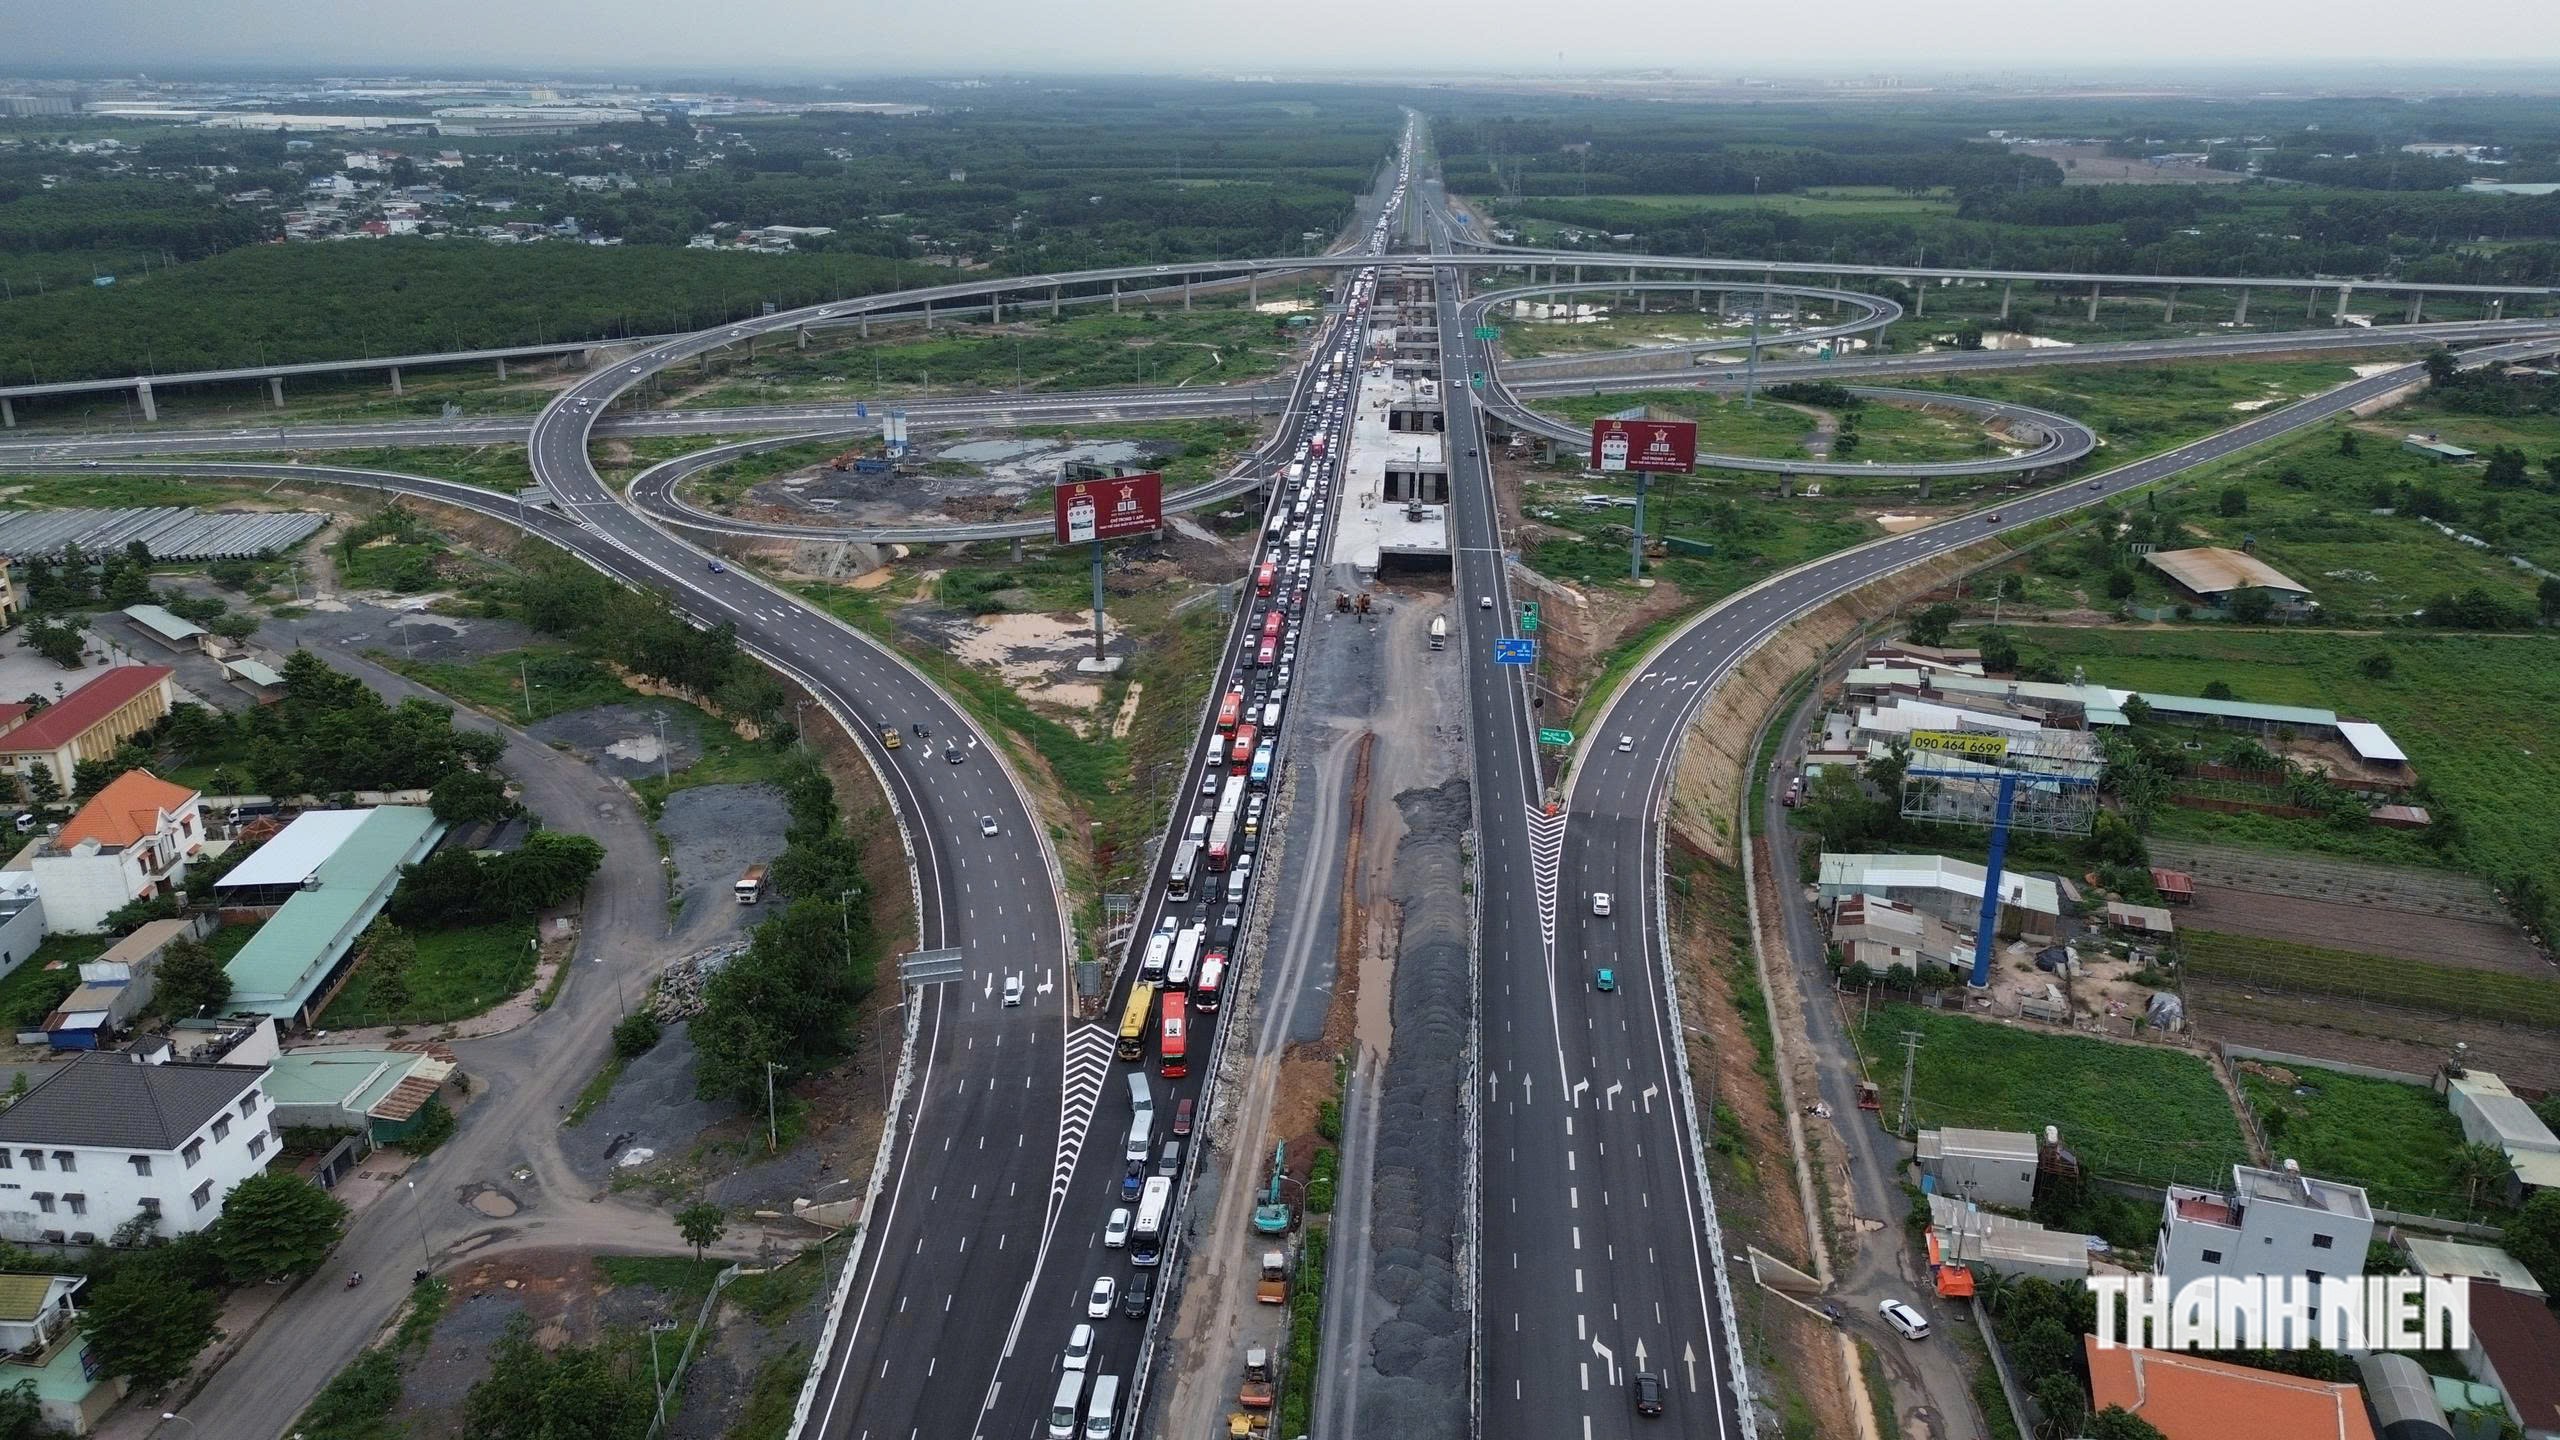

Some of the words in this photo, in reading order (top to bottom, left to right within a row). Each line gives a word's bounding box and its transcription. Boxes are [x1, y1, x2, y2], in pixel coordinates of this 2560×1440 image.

[1915, 737, 1938, 749] 090
[1942, 740, 1966, 751] 464
[1969, 742, 2001, 753] 6699
